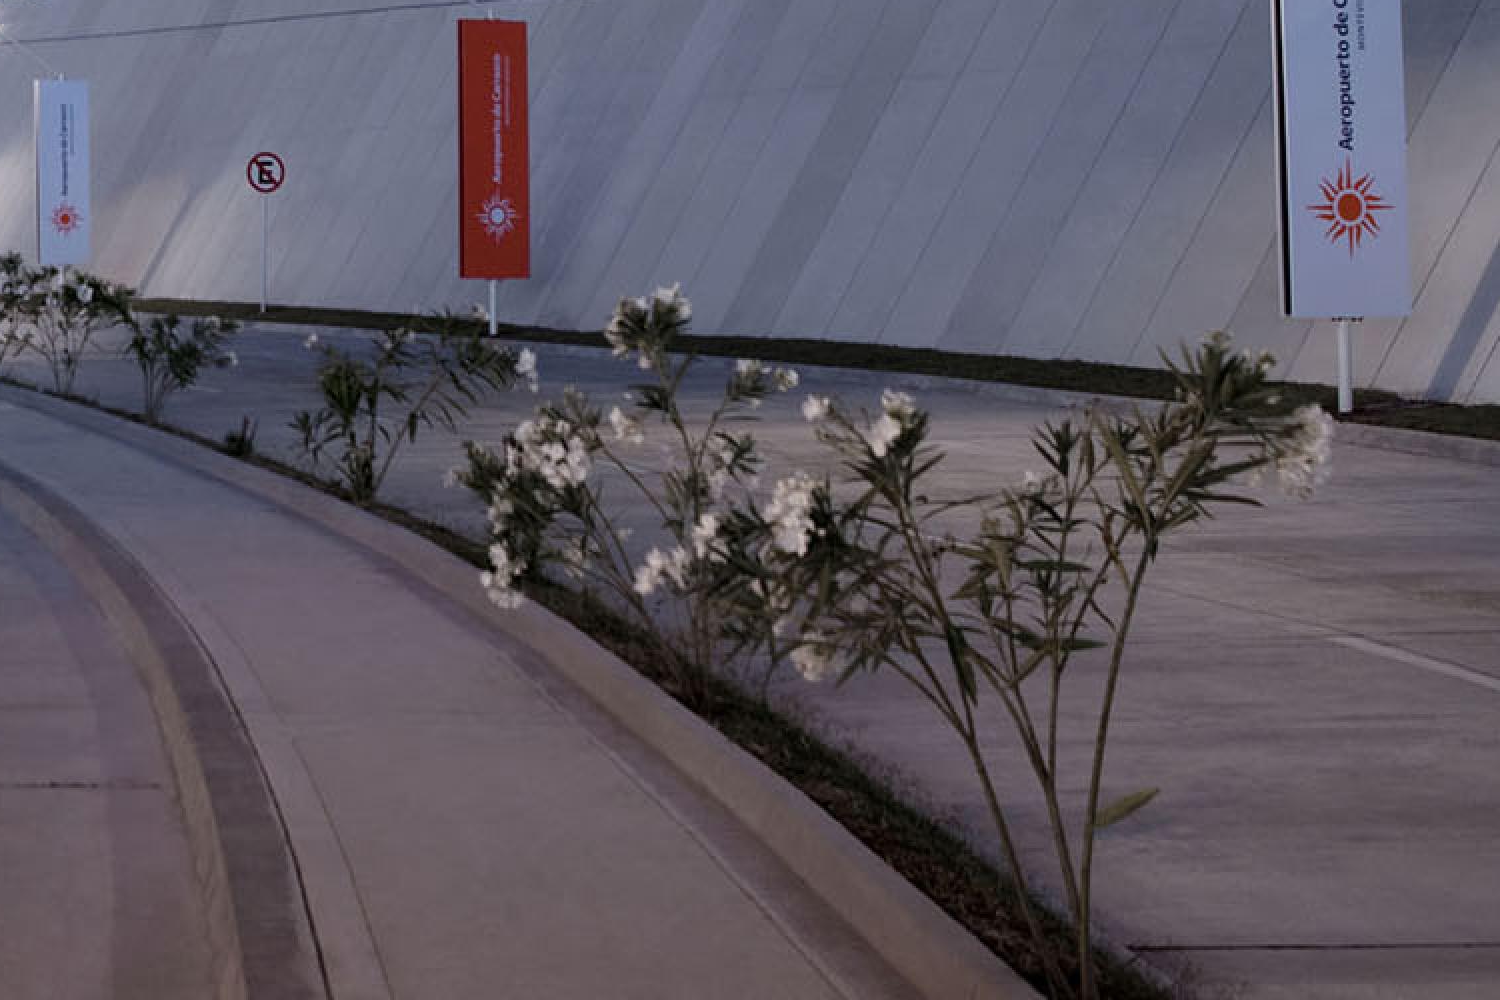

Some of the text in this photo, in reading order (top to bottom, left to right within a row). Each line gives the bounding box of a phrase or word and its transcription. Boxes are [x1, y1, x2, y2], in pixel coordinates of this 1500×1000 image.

[1333, 11, 1349, 37] de
[1335, 40, 1355, 151] Aeropuerto
[257, 161, 273, 184] E
